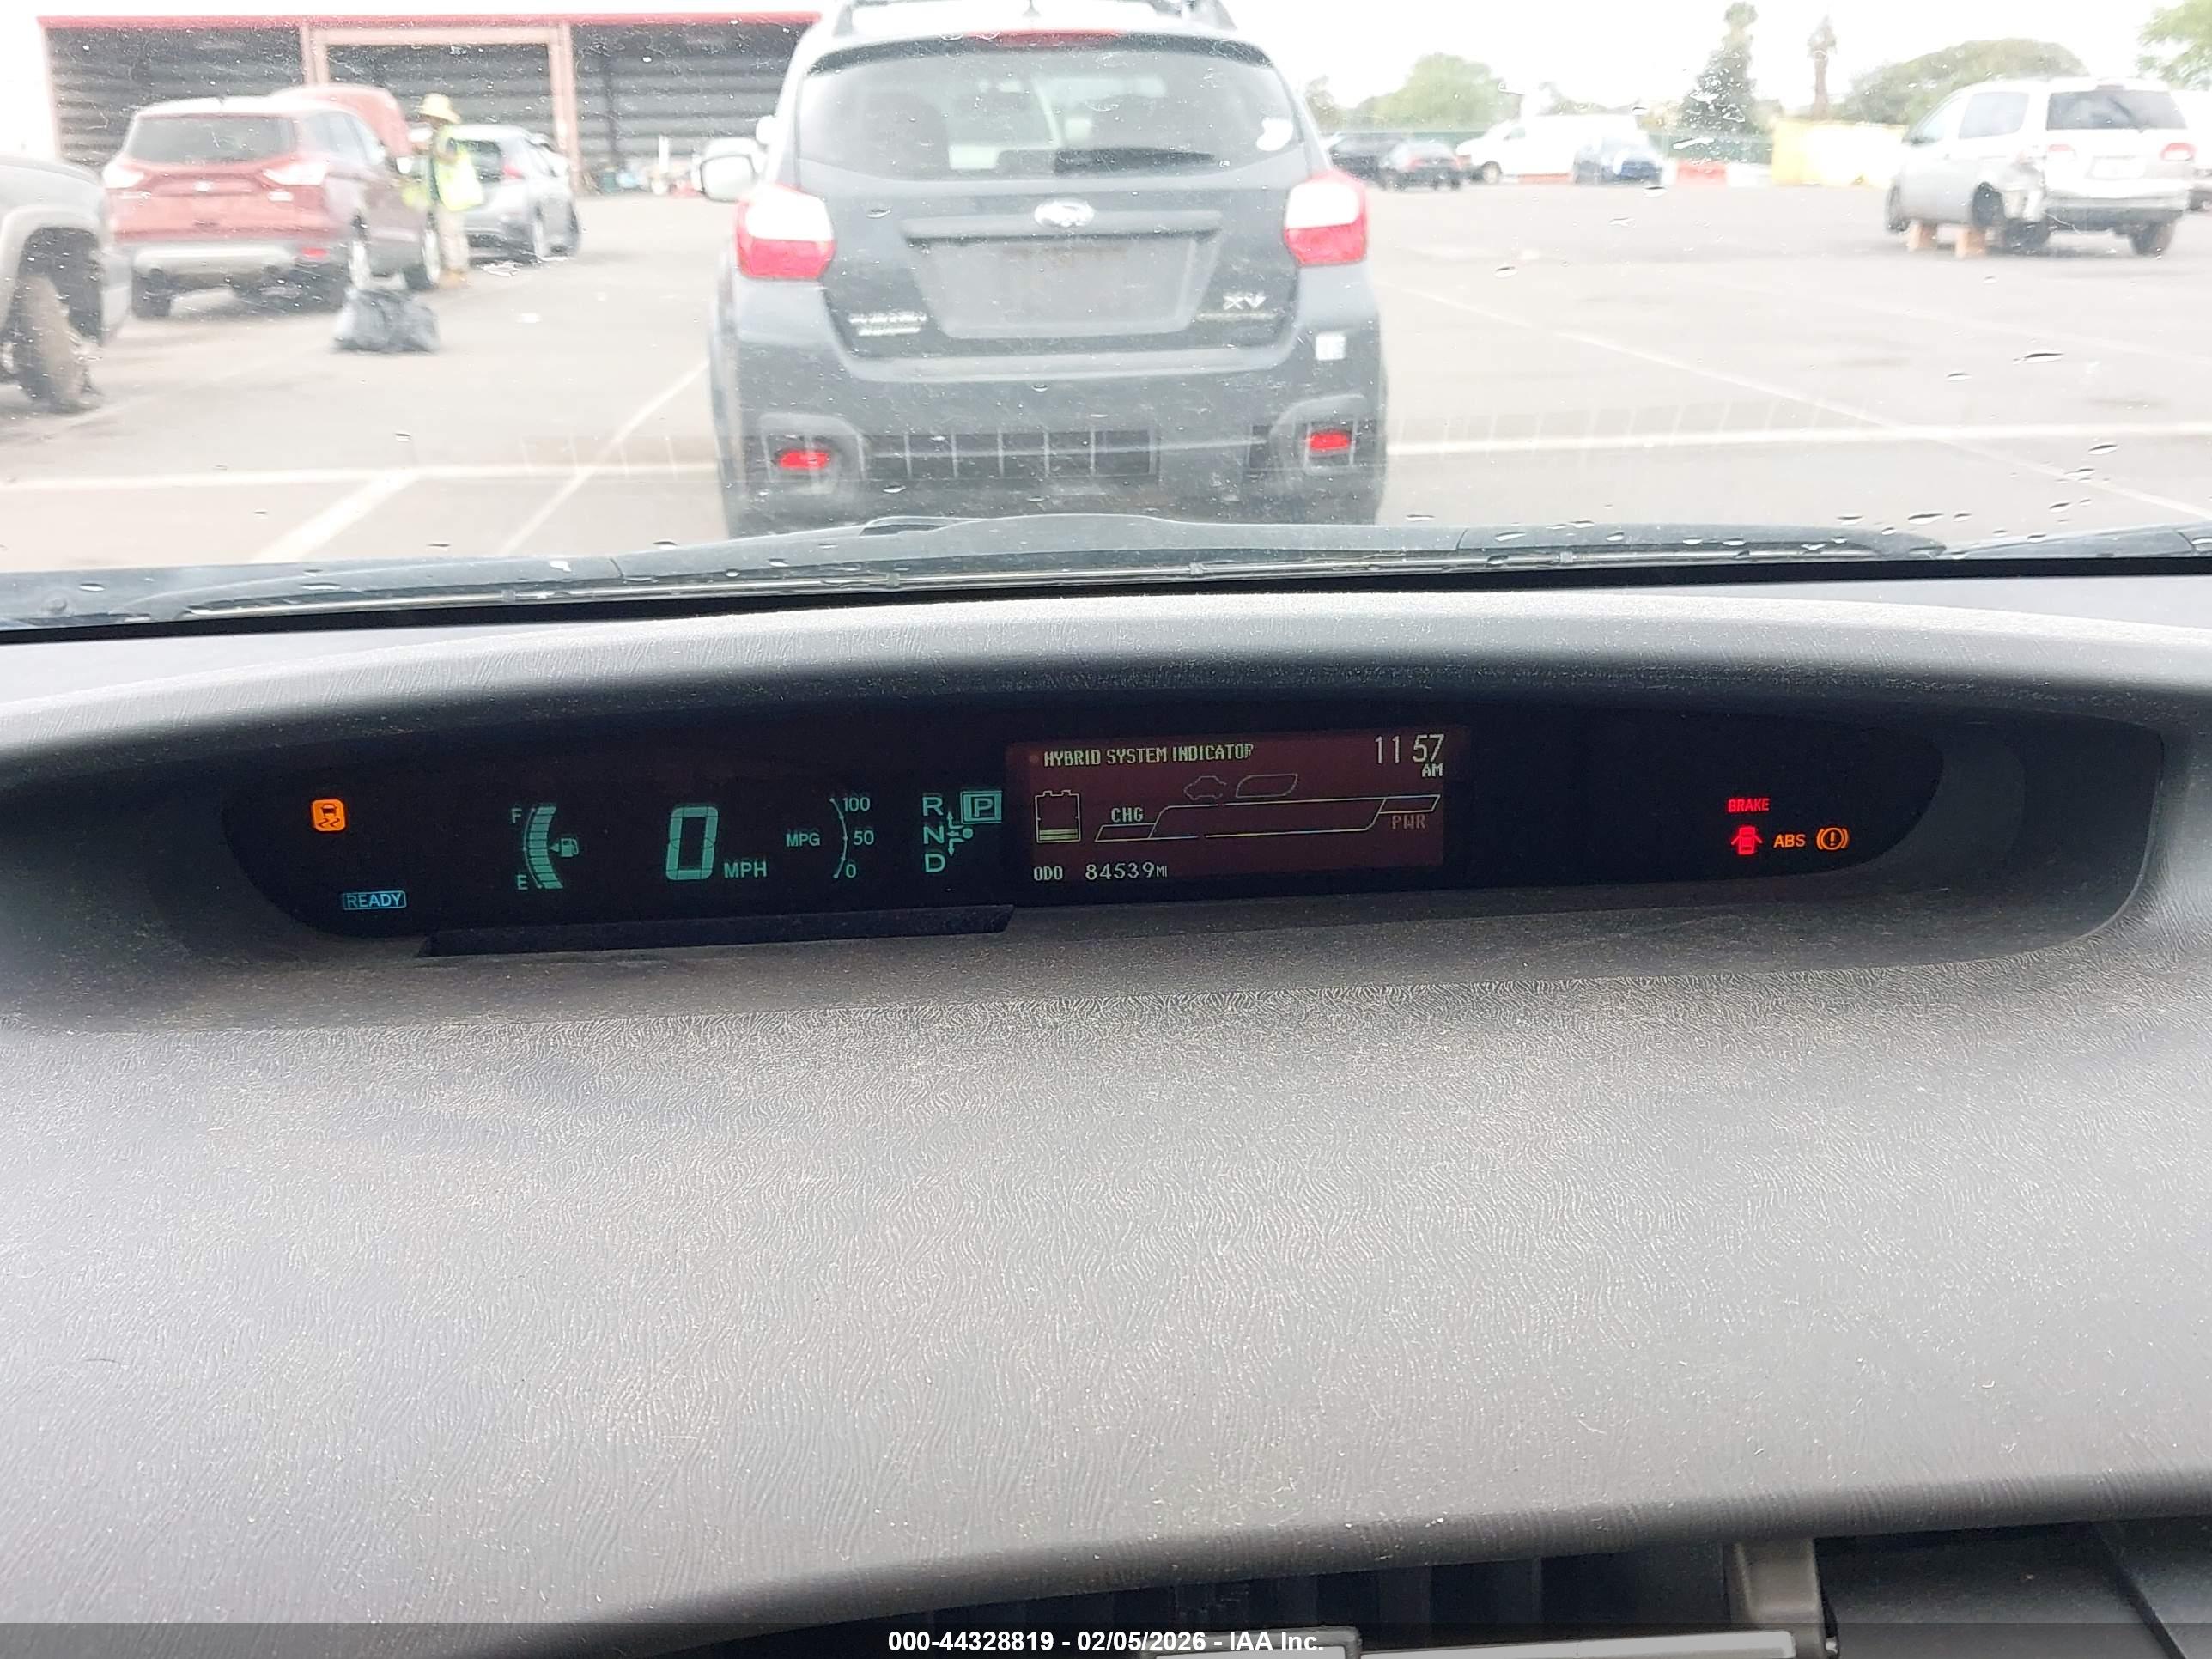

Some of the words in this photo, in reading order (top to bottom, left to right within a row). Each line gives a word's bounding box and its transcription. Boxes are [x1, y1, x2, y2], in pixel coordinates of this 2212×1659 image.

[1044, 750, 1101, 766] HYBRID
[1107, 748, 1167, 763] SYSTEM
[1172, 744, 1255, 761] INDICATOR
[1422, 763, 1443, 777] AM
[843, 797, 870, 811] 100
[923, 796, 943, 816] R
[974, 799, 994, 817] P
[1727, 798, 1770, 813] BRAKE
[511, 809, 522, 823] F
[1110, 808, 1143, 823] CHG
[1391, 815, 1425, 830] PWR
[666, 805, 719, 880] 0
[787, 833, 821, 847] MPG
[854, 830, 874, 845] 50
[923, 826, 945, 845] N
[1773, 834, 1806, 848] ABS
[724, 861, 767, 878] MPH
[925, 854, 945, 872] D
[846, 864, 857, 878] 0
[1034, 866, 1063, 881] ODO
[517, 875, 528, 890] E
[346, 892, 402, 908] READY
